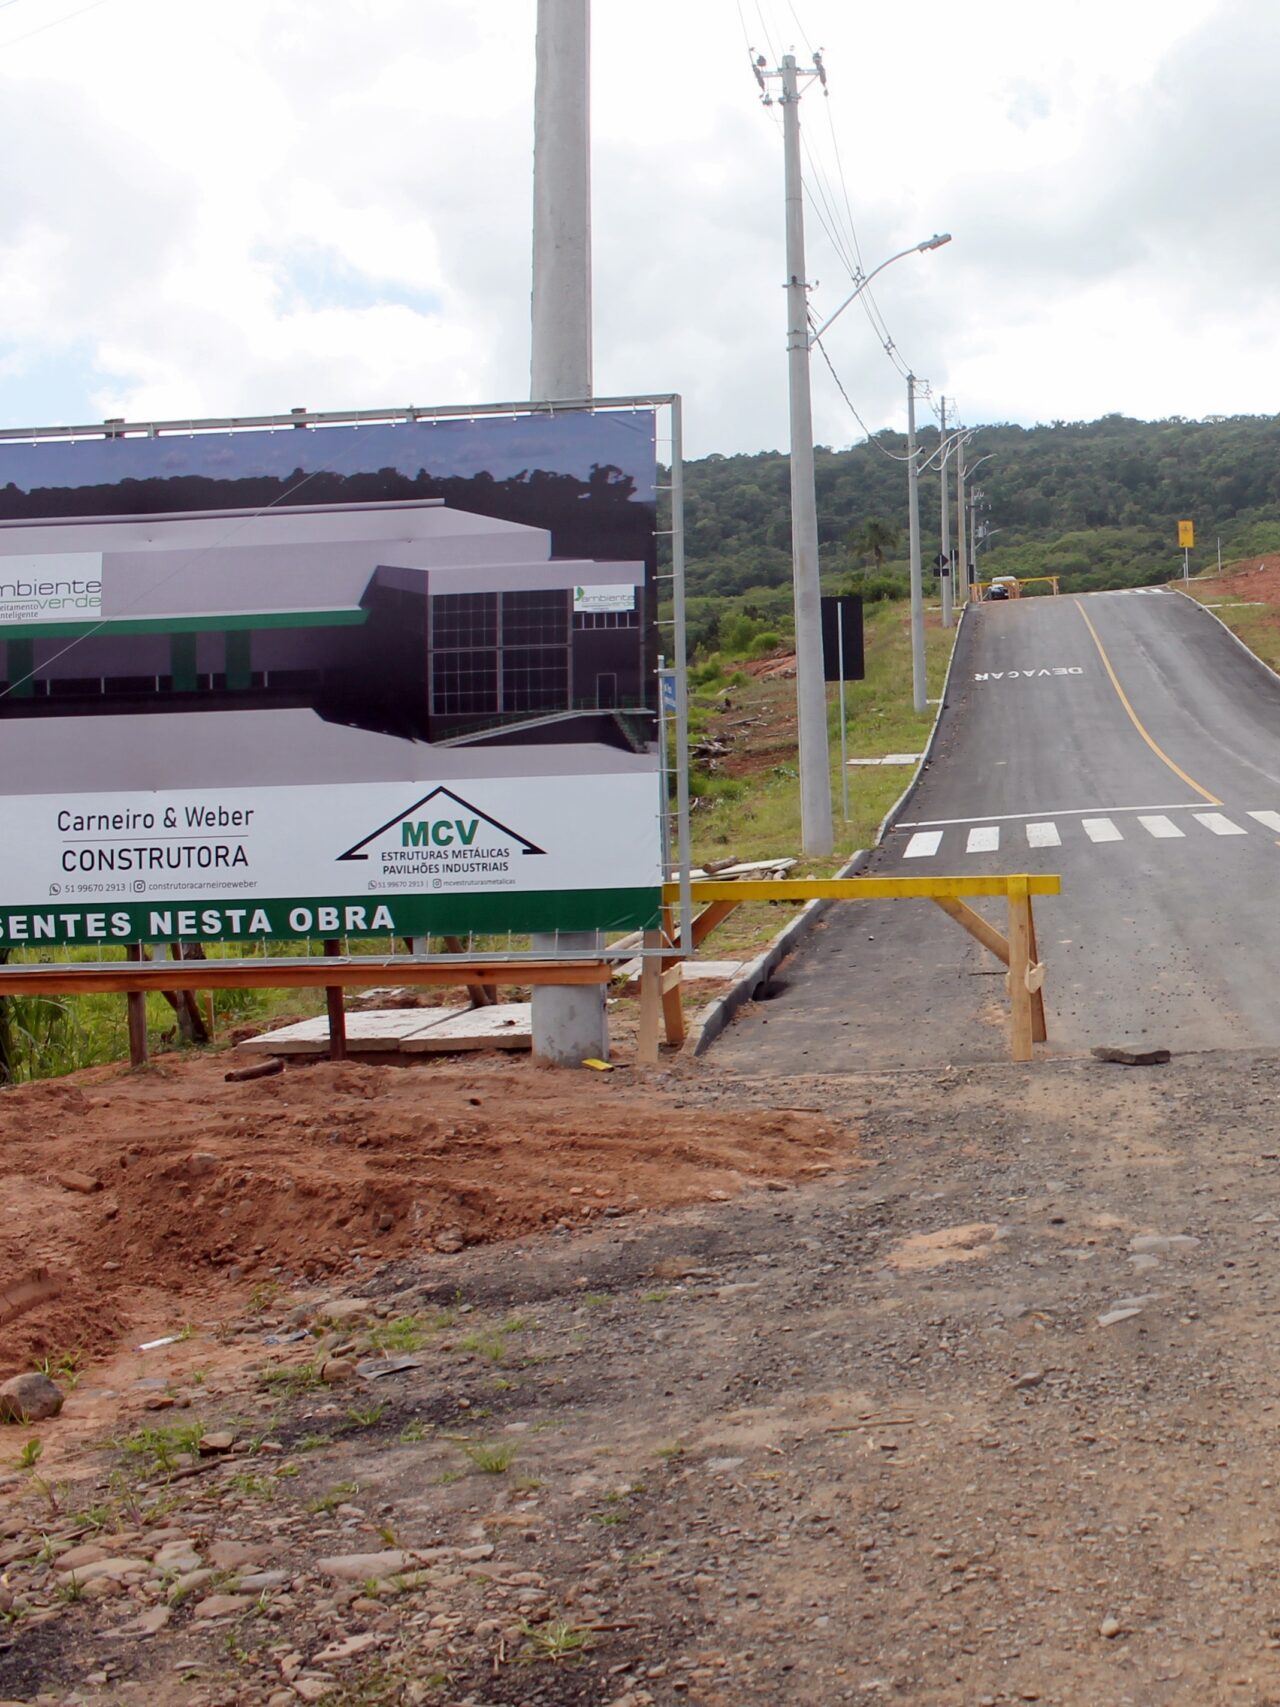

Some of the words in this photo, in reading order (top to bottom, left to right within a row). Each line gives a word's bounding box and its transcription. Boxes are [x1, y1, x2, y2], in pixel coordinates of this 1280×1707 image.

[37, 594, 102, 609] verde
[57, 808, 155, 832] Carneiro
[163, 806, 178, 828] &
[185, 805, 255, 828] Weber
[401, 819, 480, 847] MCV
[61, 844, 249, 872] CONSTRUTORA
[381, 849, 449, 862] ESTRUTURAS
[451, 847, 510, 860] METÁLICAS
[383, 862, 440, 875] PAVILHÕES
[442, 861, 509, 874] INDUSTRIAIS
[65, 884, 76, 893] 51
[78, 883, 103, 893] 99670
[105, 882, 126, 892] 2913
[148, 880, 258, 891] construtoracarneiroeweber
[0, 912, 131, 940] ENTES
[150, 908, 272, 936] NESTA
[289, 905, 396, 932] OBRA
